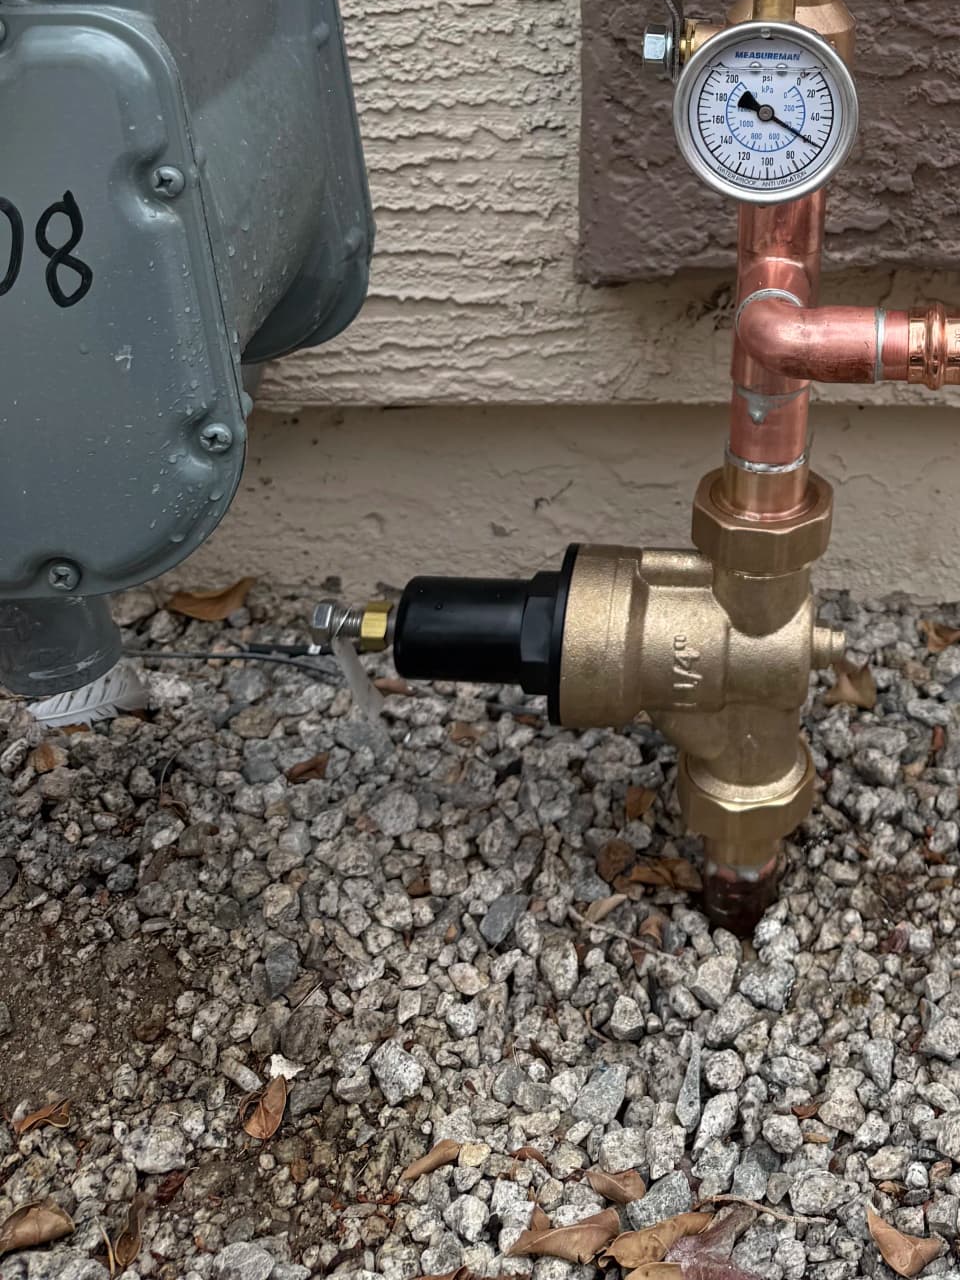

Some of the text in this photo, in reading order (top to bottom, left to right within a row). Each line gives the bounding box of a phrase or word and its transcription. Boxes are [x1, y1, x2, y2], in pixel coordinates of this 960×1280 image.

[735, 51, 800, 61] MEASUREMAN
[726, 74, 739, 84] 200
[762, 74, 773, 82] psi
[761, 85, 774, 94] kPa
[806, 89, 816, 98] 20
[715, 92, 728, 102] 180
[712, 115, 725, 124] 160
[810, 112, 820, 121] 40
[739, 120, 754, 128] 1000
[720, 135, 733, 145] 140
[750, 132, 763, 140] 800
[768, 132, 780, 140] 600
[738, 152, 751, 161] 120
[786, 151, 795, 159] 80
[761, 157, 774, 166] 100
